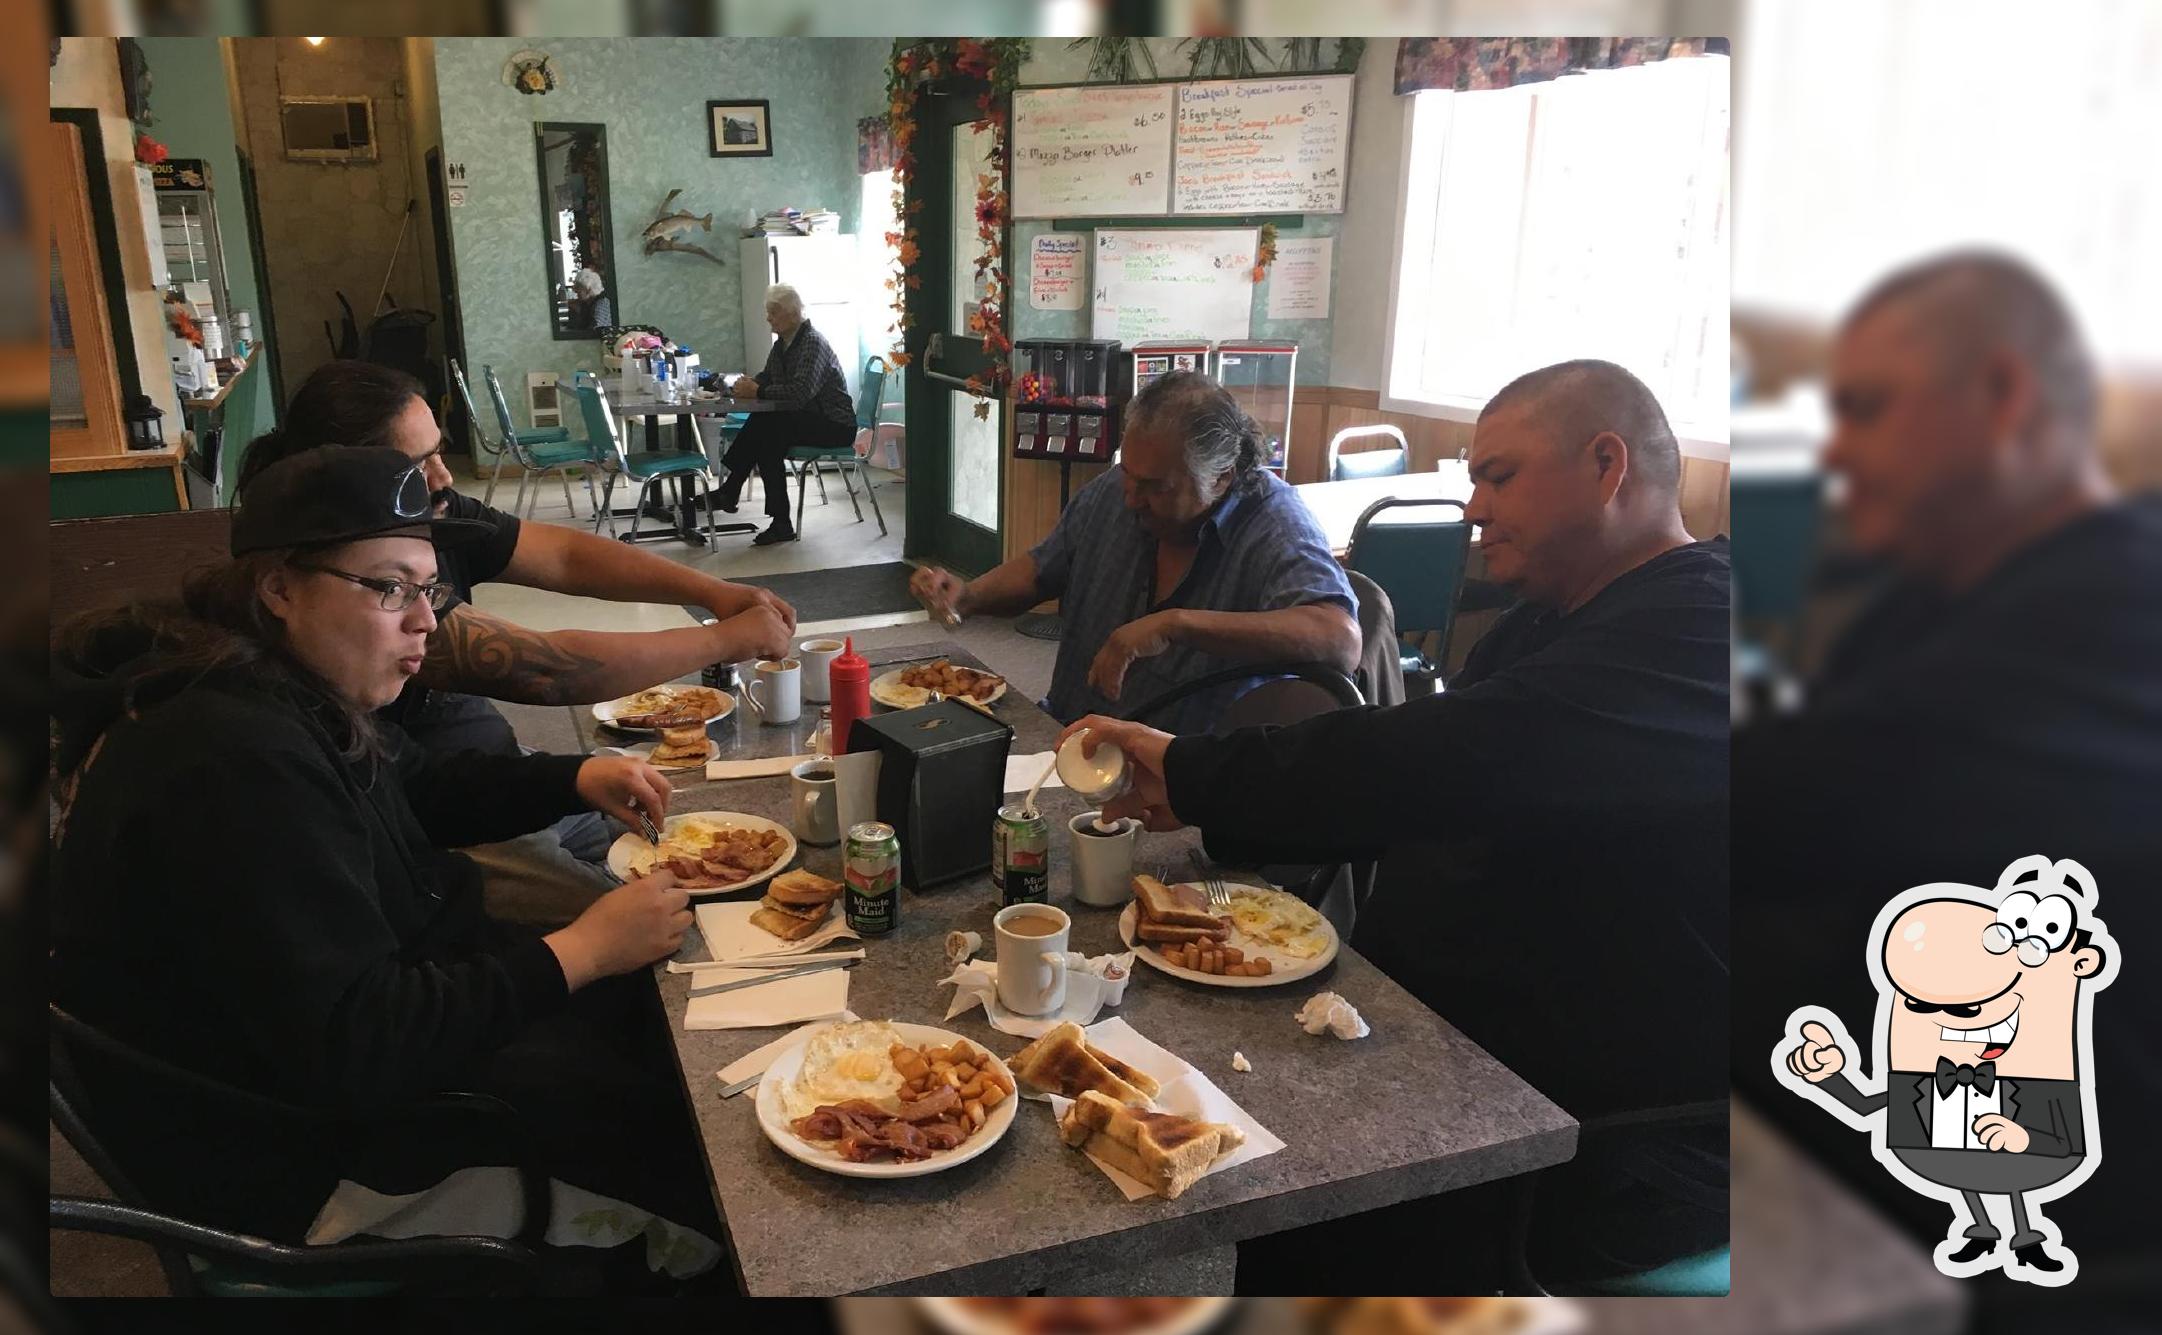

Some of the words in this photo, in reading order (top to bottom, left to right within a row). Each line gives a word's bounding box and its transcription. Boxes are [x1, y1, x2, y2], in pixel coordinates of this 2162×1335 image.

[1181, 86, 1231, 103] Breakfast
[1235, 83, 1273, 100] Special
[853, 896, 890, 908] Minute
[858, 905, 885, 917] Maid
